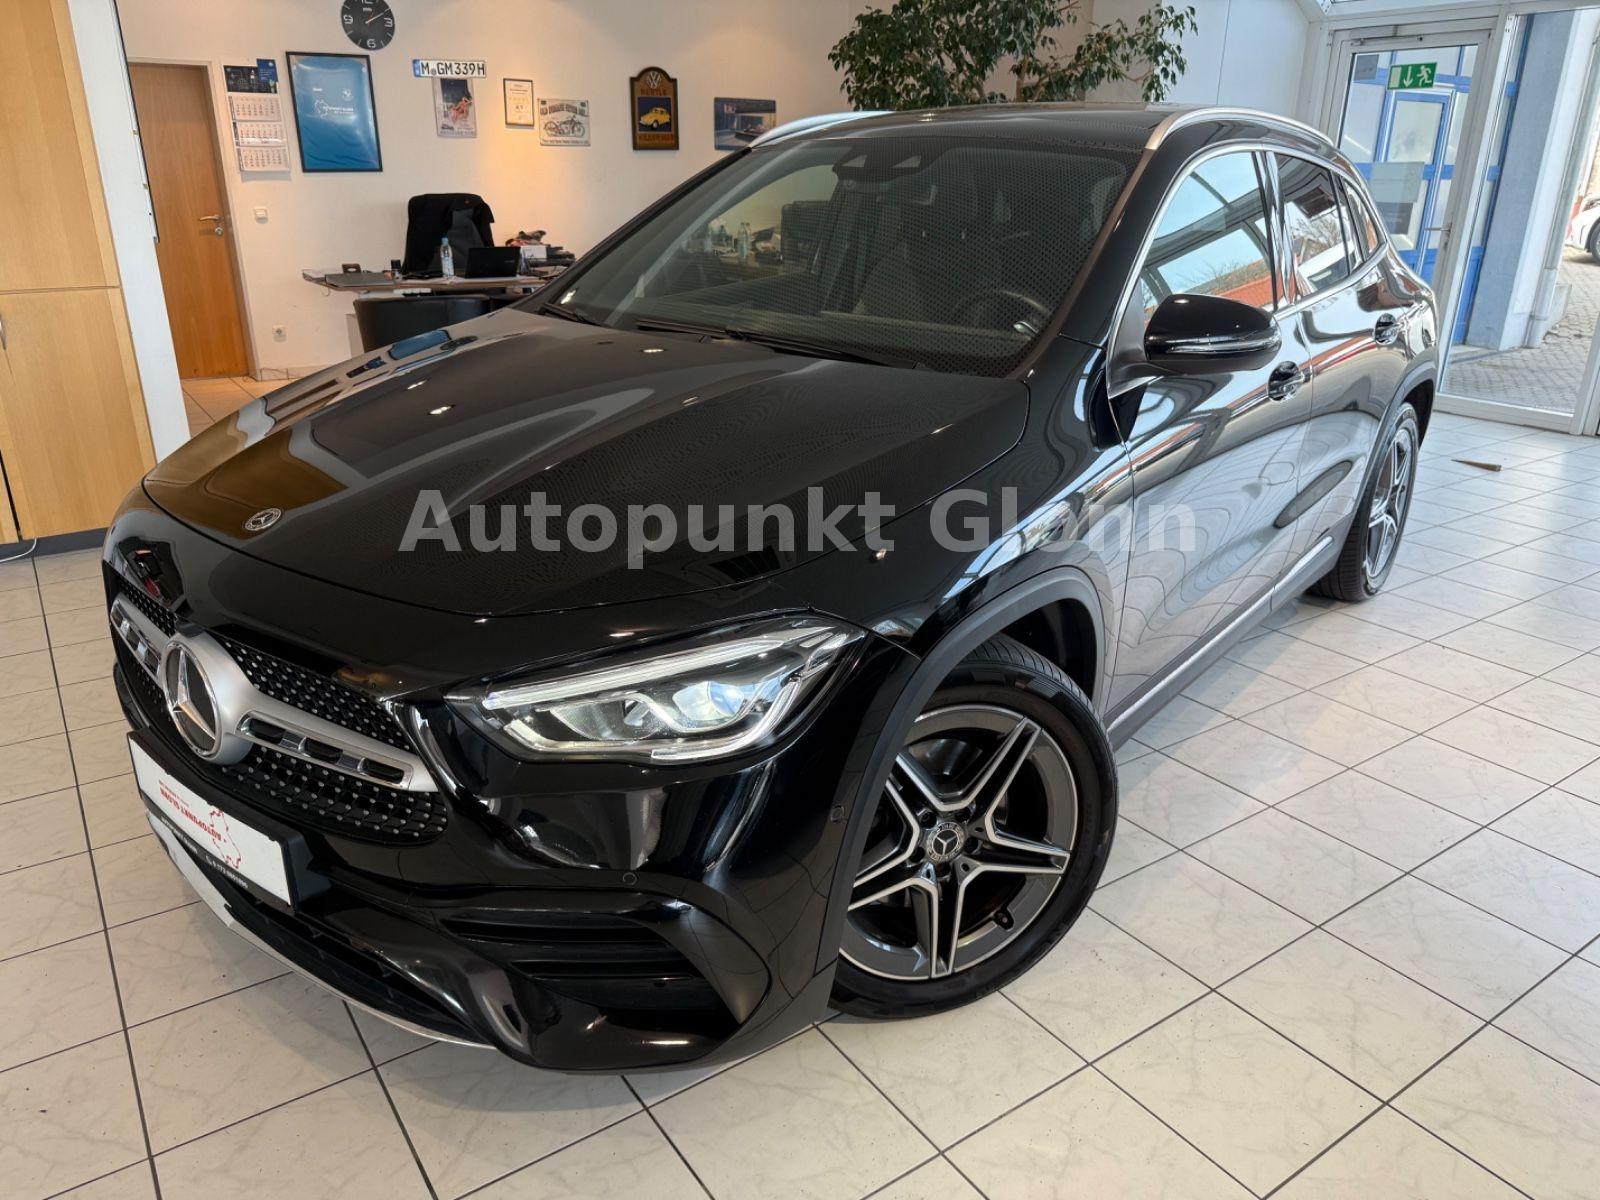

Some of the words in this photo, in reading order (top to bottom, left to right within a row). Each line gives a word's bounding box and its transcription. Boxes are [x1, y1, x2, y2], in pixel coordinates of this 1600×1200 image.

[343, 14, 354, 25] 9
[384, 17, 394, 28] 3
[366, 38, 376, 48] 6
